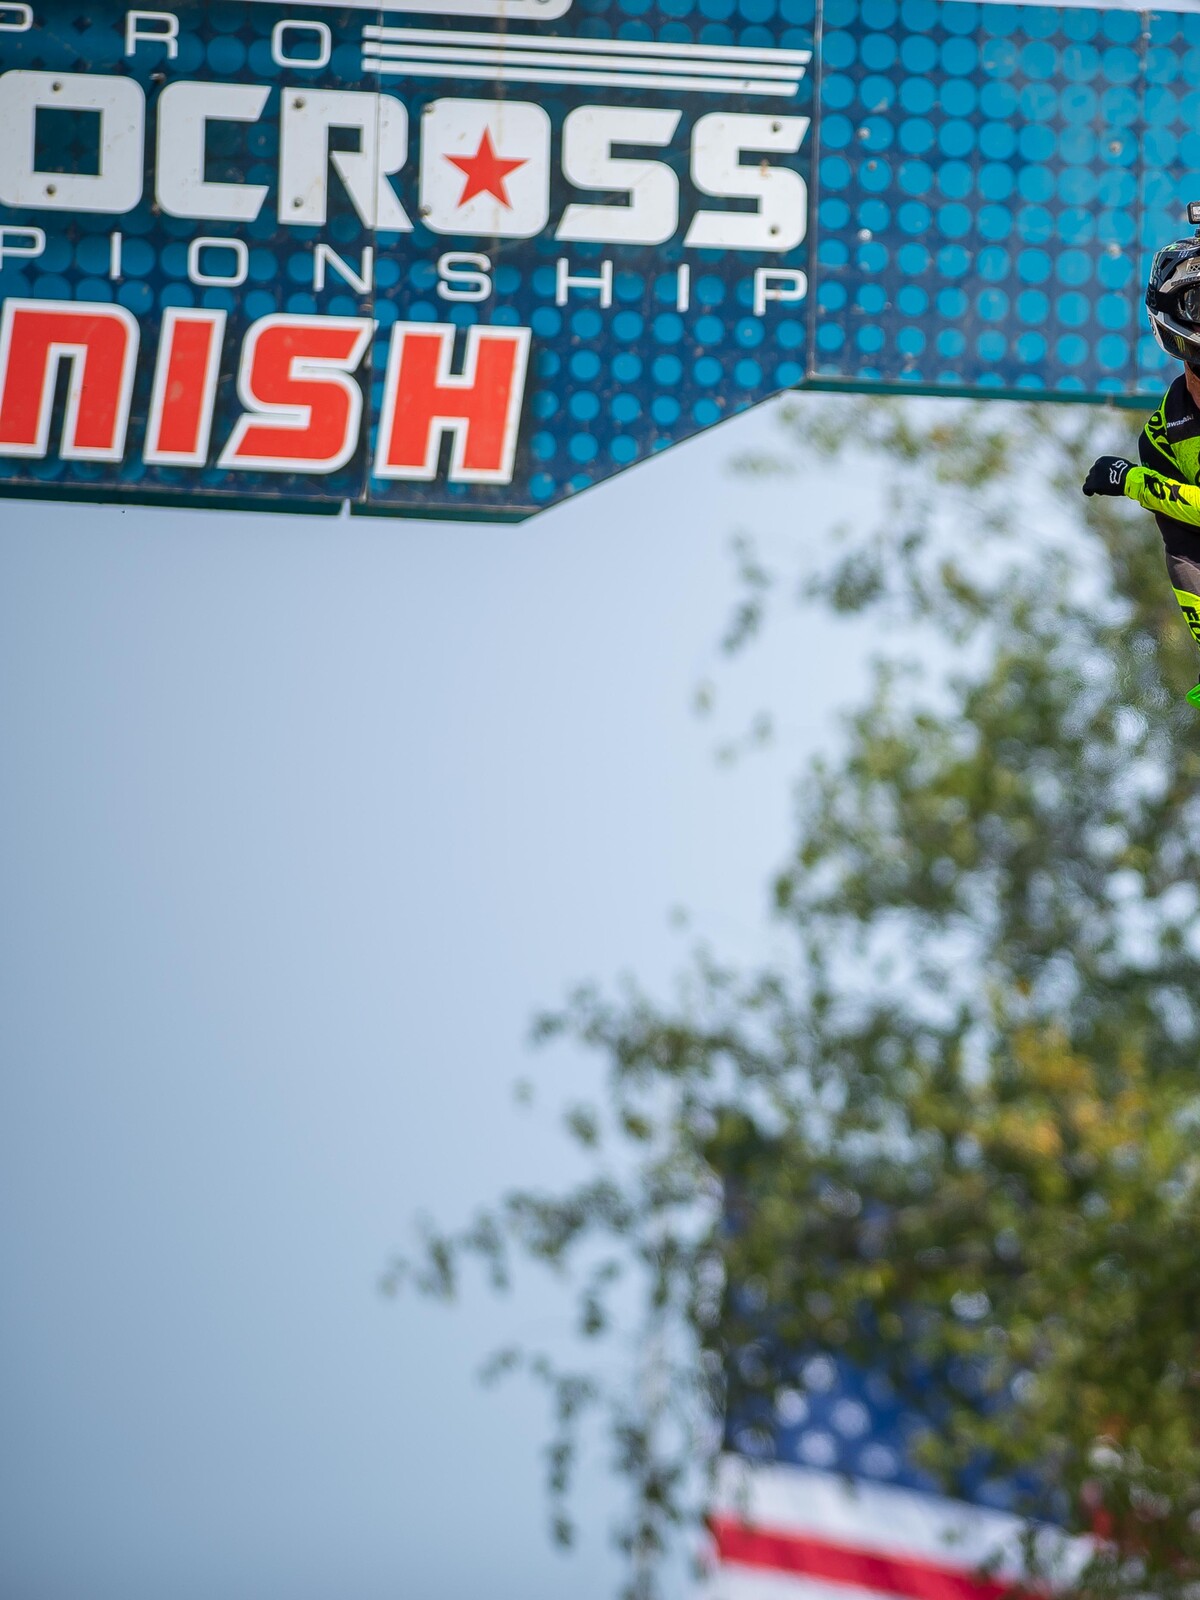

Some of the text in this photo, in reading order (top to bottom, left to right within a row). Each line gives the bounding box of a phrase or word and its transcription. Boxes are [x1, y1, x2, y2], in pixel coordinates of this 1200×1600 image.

[0, 3, 331, 70] PRO
[0, 69, 811, 253] OCROSS
[0, 225, 807, 317] PIONSHIP
[0, 297, 532, 485] NISH
